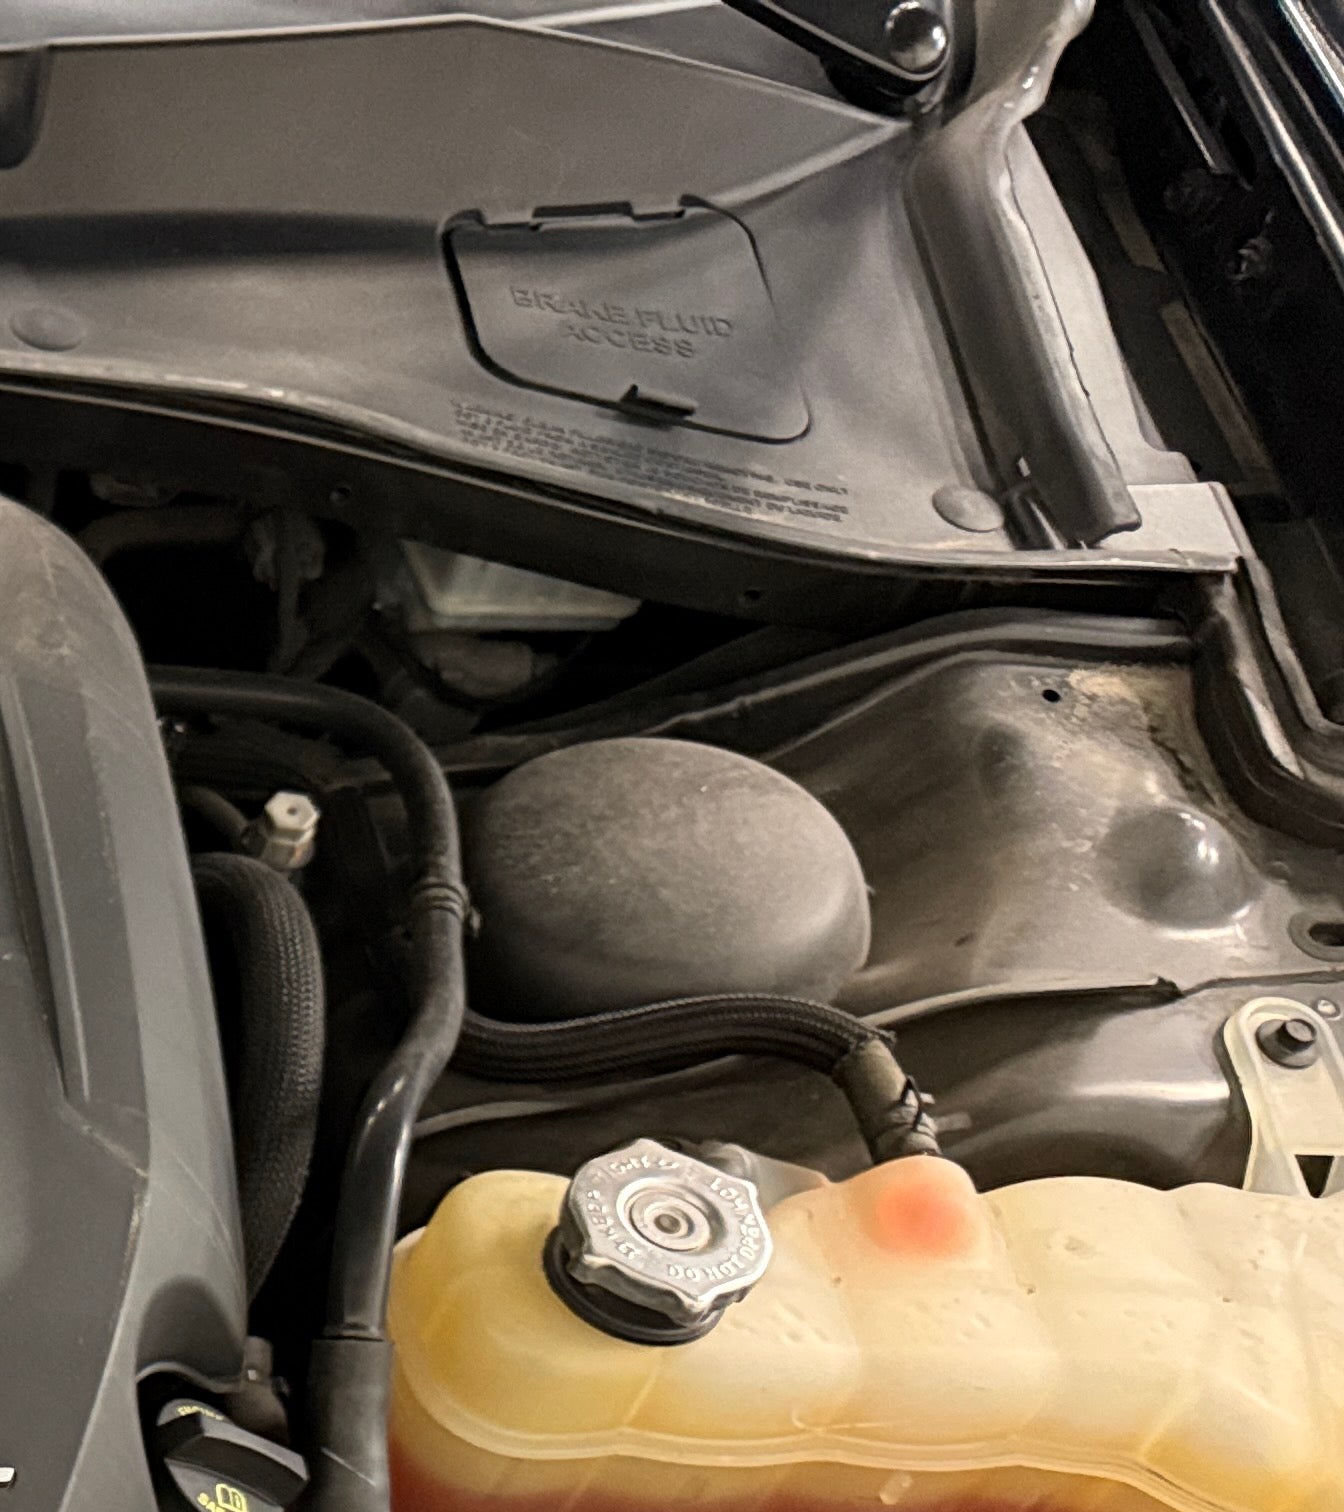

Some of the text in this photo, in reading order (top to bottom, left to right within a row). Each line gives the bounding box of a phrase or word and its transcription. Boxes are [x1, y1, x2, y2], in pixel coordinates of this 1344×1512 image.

[510, 285, 734, 338] BRAKE FLUID
[563, 322, 695, 359] ACCESS
